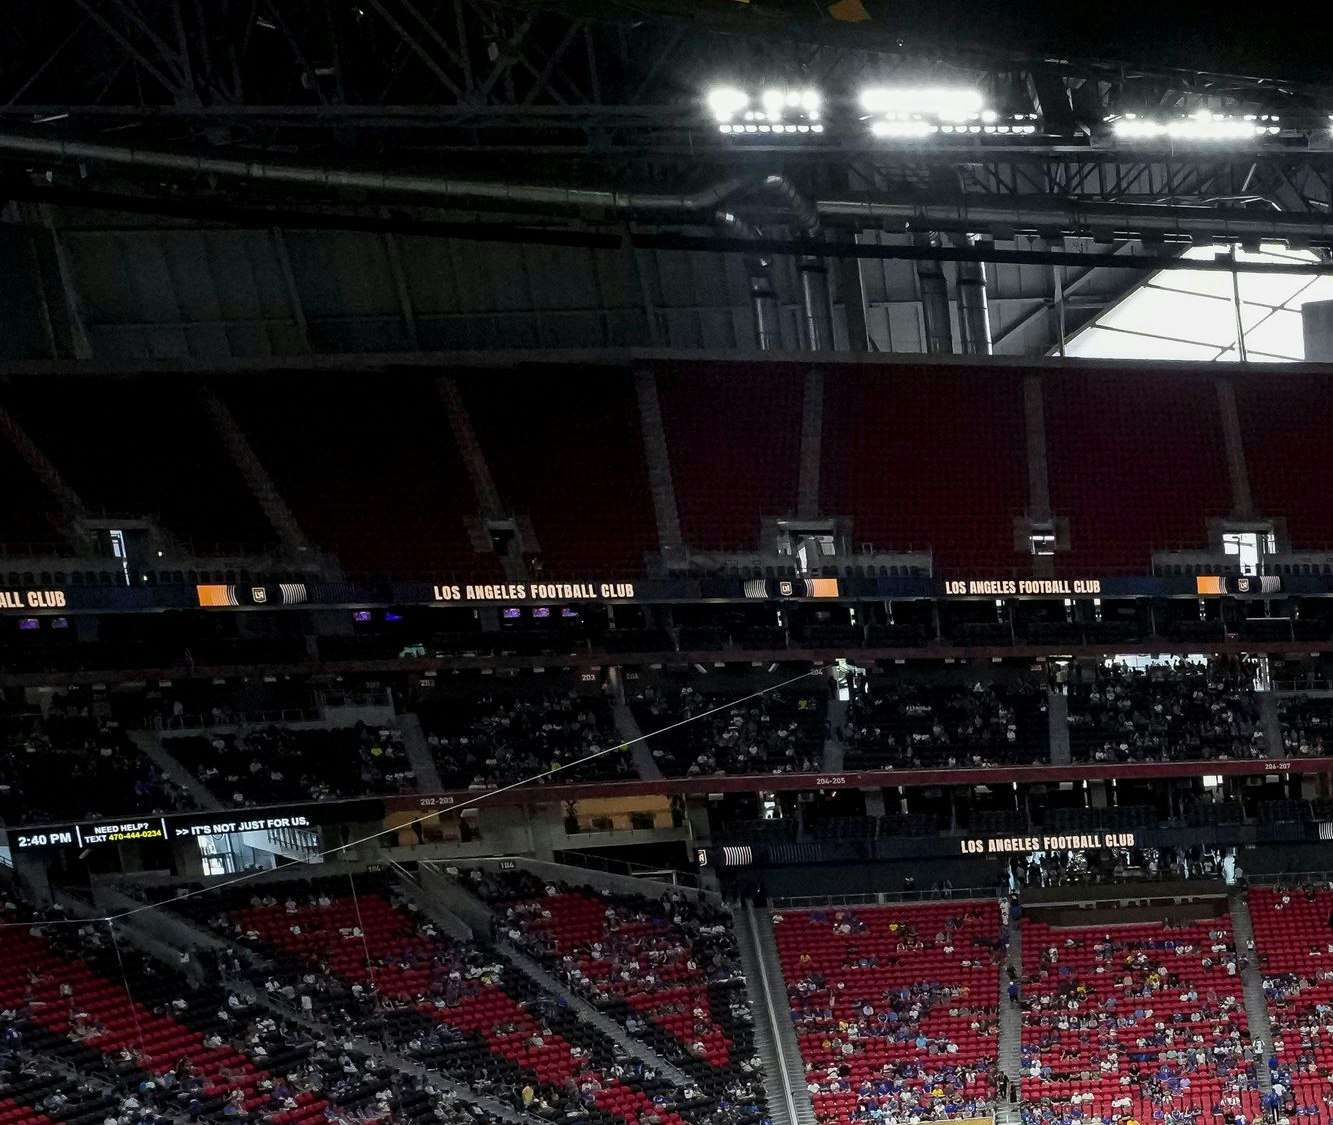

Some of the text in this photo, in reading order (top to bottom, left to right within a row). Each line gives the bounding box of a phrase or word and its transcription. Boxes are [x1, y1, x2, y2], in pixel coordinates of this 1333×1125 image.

[434, 583, 633, 600] LOS ANGELES FOOTBALL CLUB
[946, 580, 1100, 595] LOS ANGELES FOOTBALL CLUB
[28, 591, 65, 607] CLUB
[94, 821, 150, 836] NEED HELP?
[212, 823, 235, 835] NOT
[239, 820, 266, 832] JUST
[267, 818, 290, 830] FOR
[18, 831, 72, 849] 2:40 PM
[84, 834, 107, 845] TEXT
[960, 833, 1134, 854] LOS ANGELES FOOTBALL CLUB
